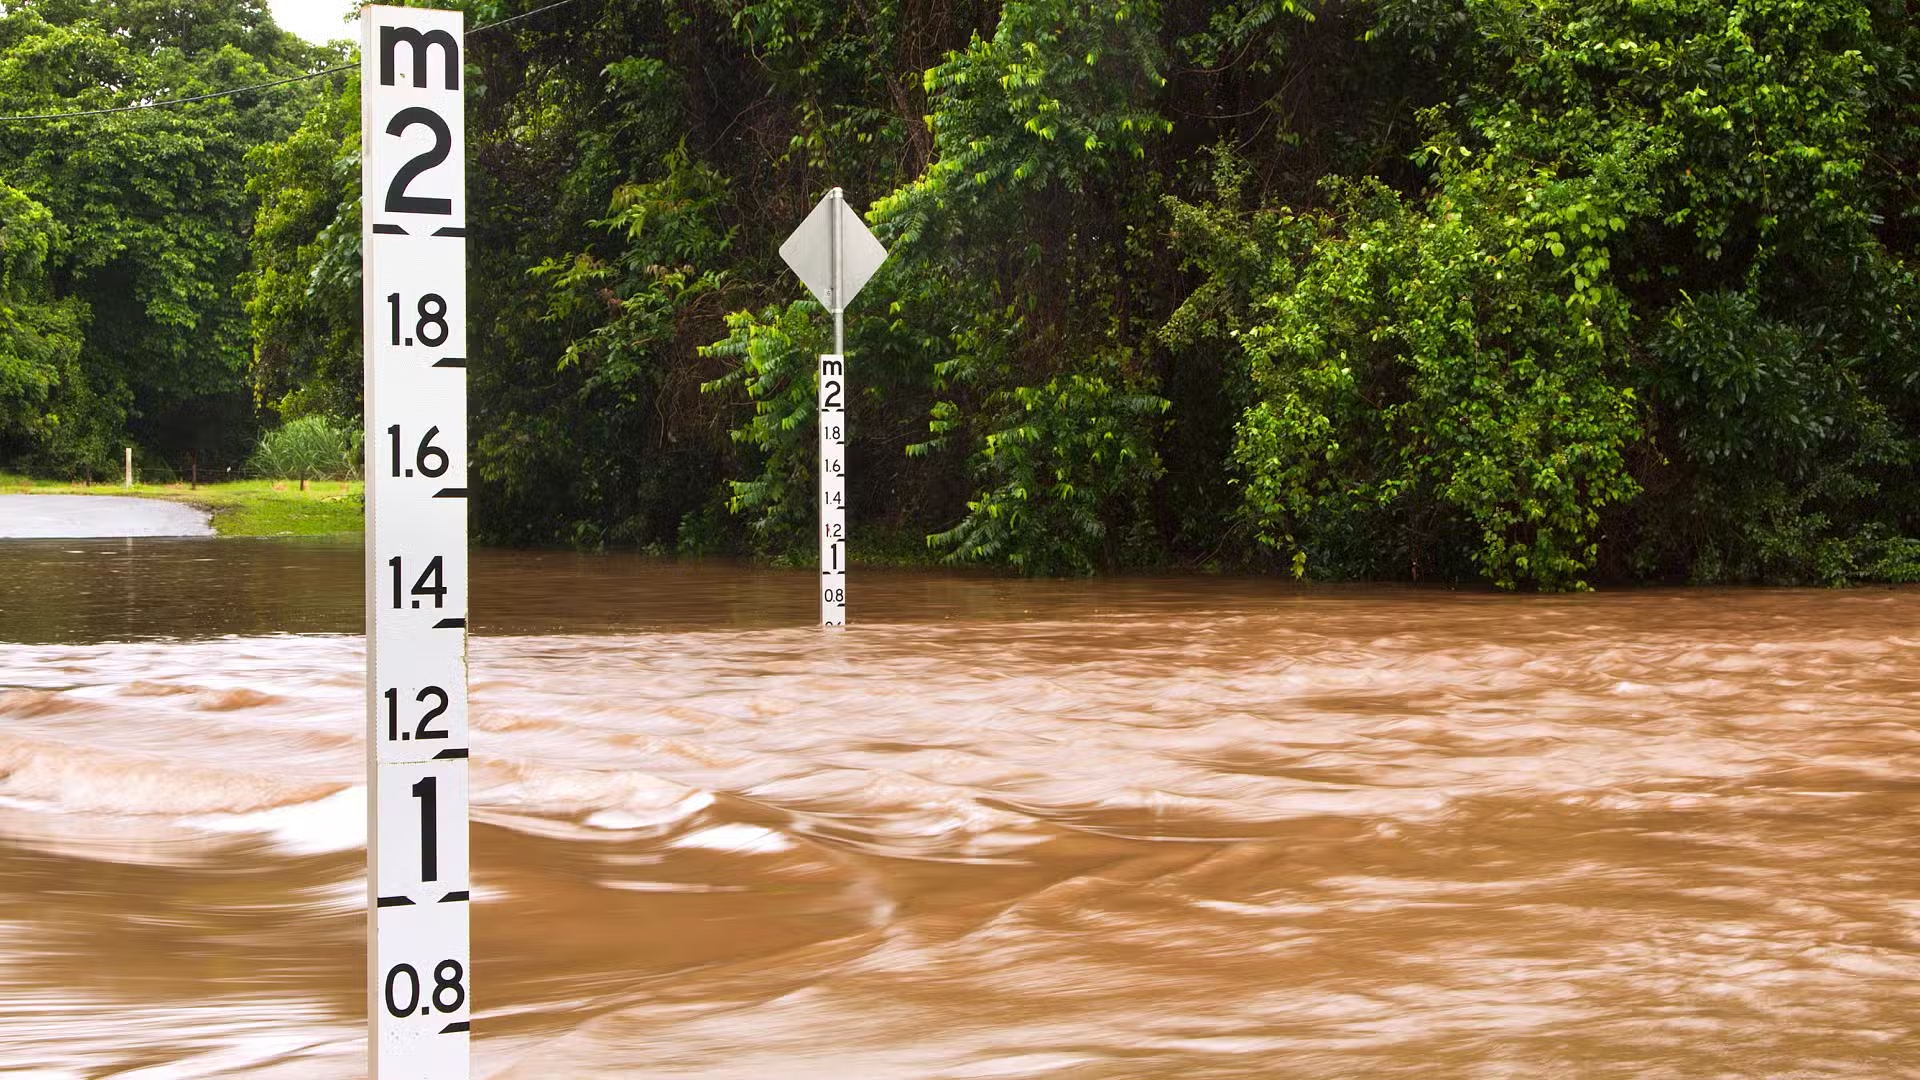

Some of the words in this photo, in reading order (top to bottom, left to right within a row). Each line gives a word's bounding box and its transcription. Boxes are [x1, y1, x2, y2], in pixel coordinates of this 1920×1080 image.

[380, 26, 459, 90] m
[385, 107, 451, 215] 2
[388, 293, 448, 347] 1.8
[823, 361, 842, 375] m
[825, 381, 841, 407] 2
[388, 424, 449, 478] 1.6
[825, 426, 840, 439] 1.8
[825, 459, 840, 472] 1.6
[825, 491, 841, 504] 1.4
[826, 524, 841, 537] 1.2
[831, 544, 837, 570] 1
[389, 556, 447, 609] 1.4
[825, 589, 843, 602] 0.8
[385, 686, 448, 741] 1.2
[412, 777, 437, 882] 1
[385, 959, 465, 1018] 0.8
